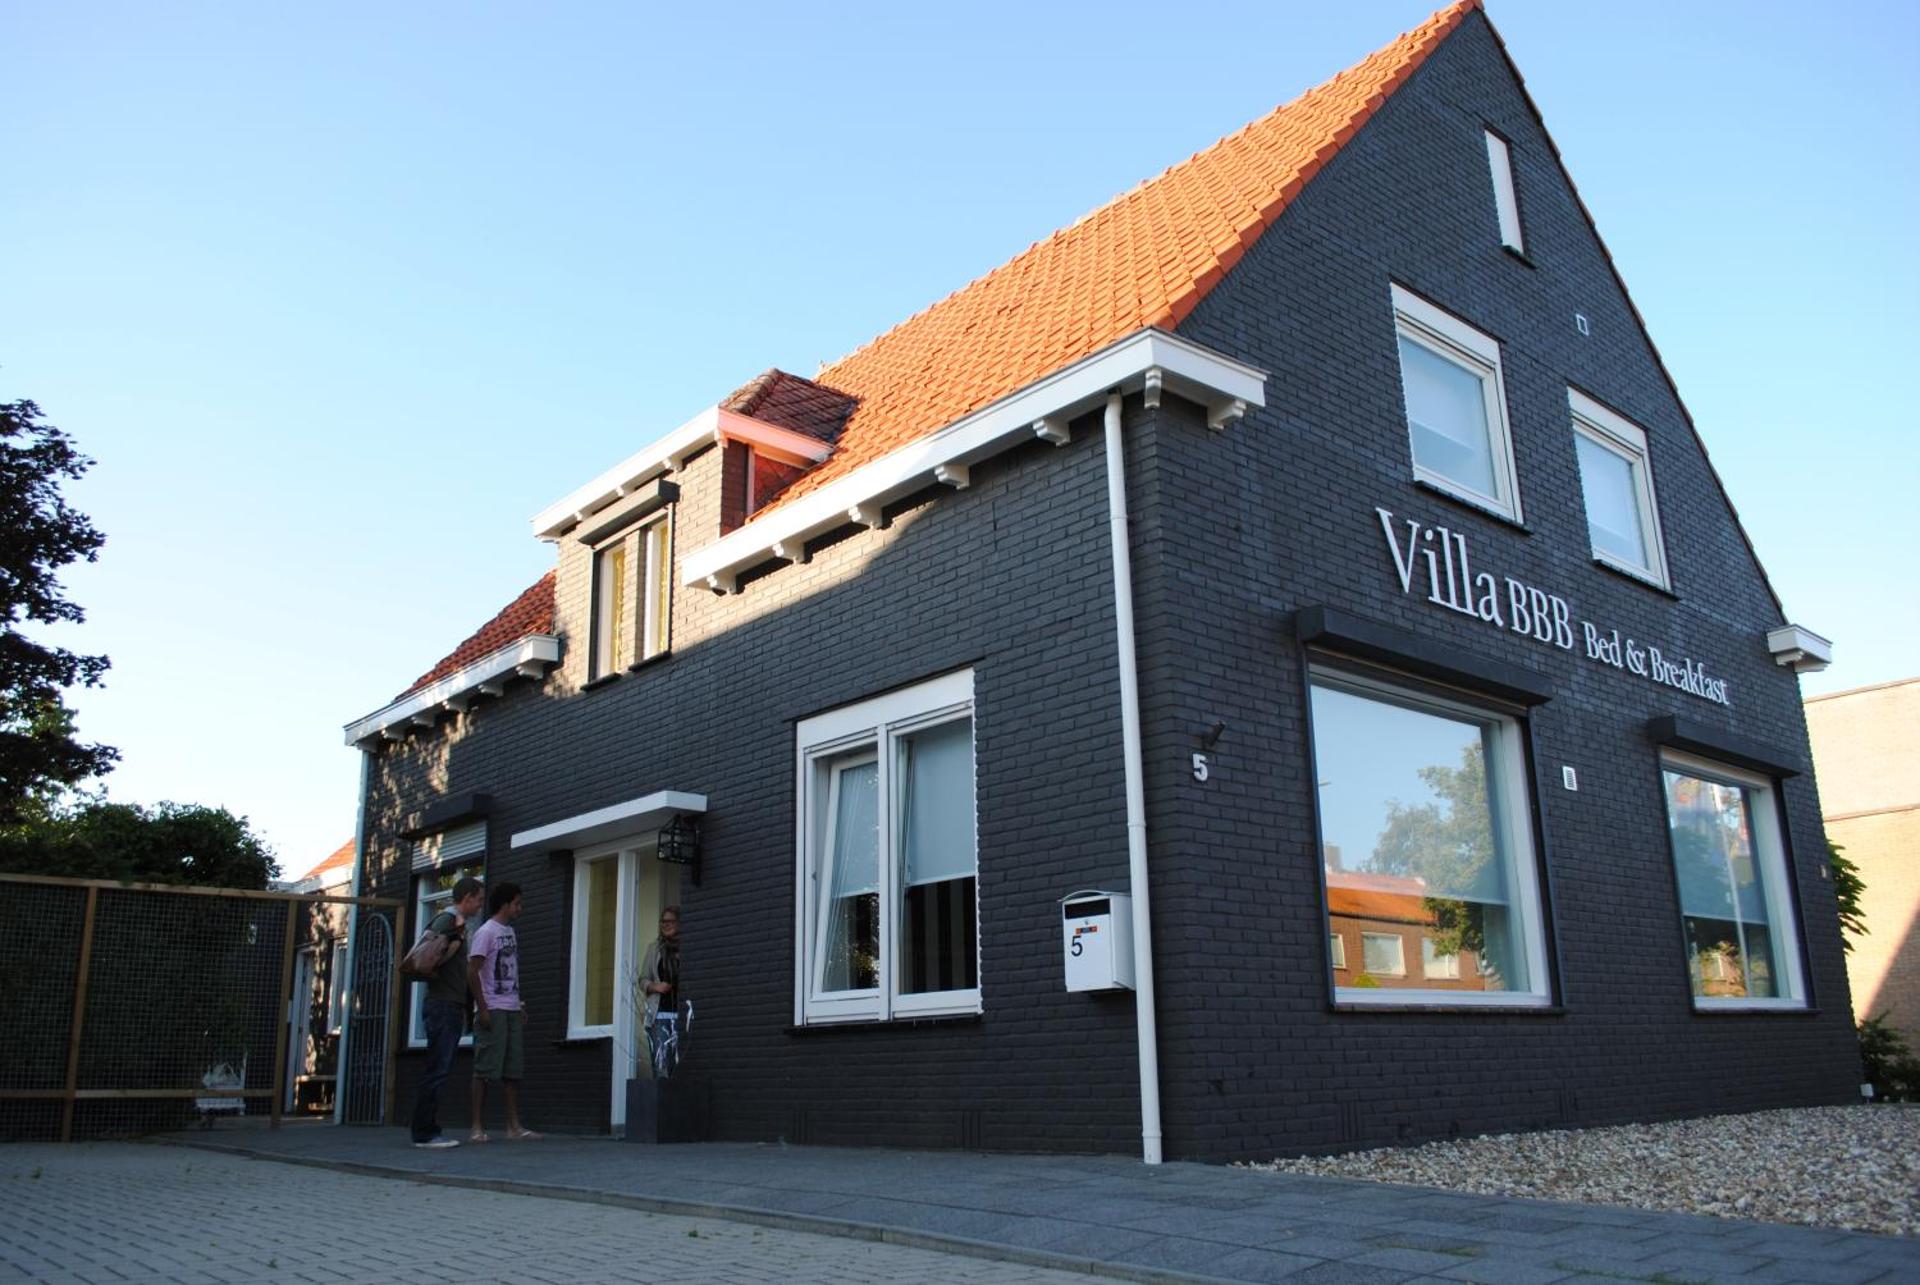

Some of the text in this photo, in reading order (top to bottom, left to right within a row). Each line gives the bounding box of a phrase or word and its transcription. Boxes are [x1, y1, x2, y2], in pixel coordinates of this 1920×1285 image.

[1375, 507, 1730, 705] Villa BBB Bed & Breakfast
[1192, 753, 1208, 781] 5
[1071, 935, 1083, 957] 5
